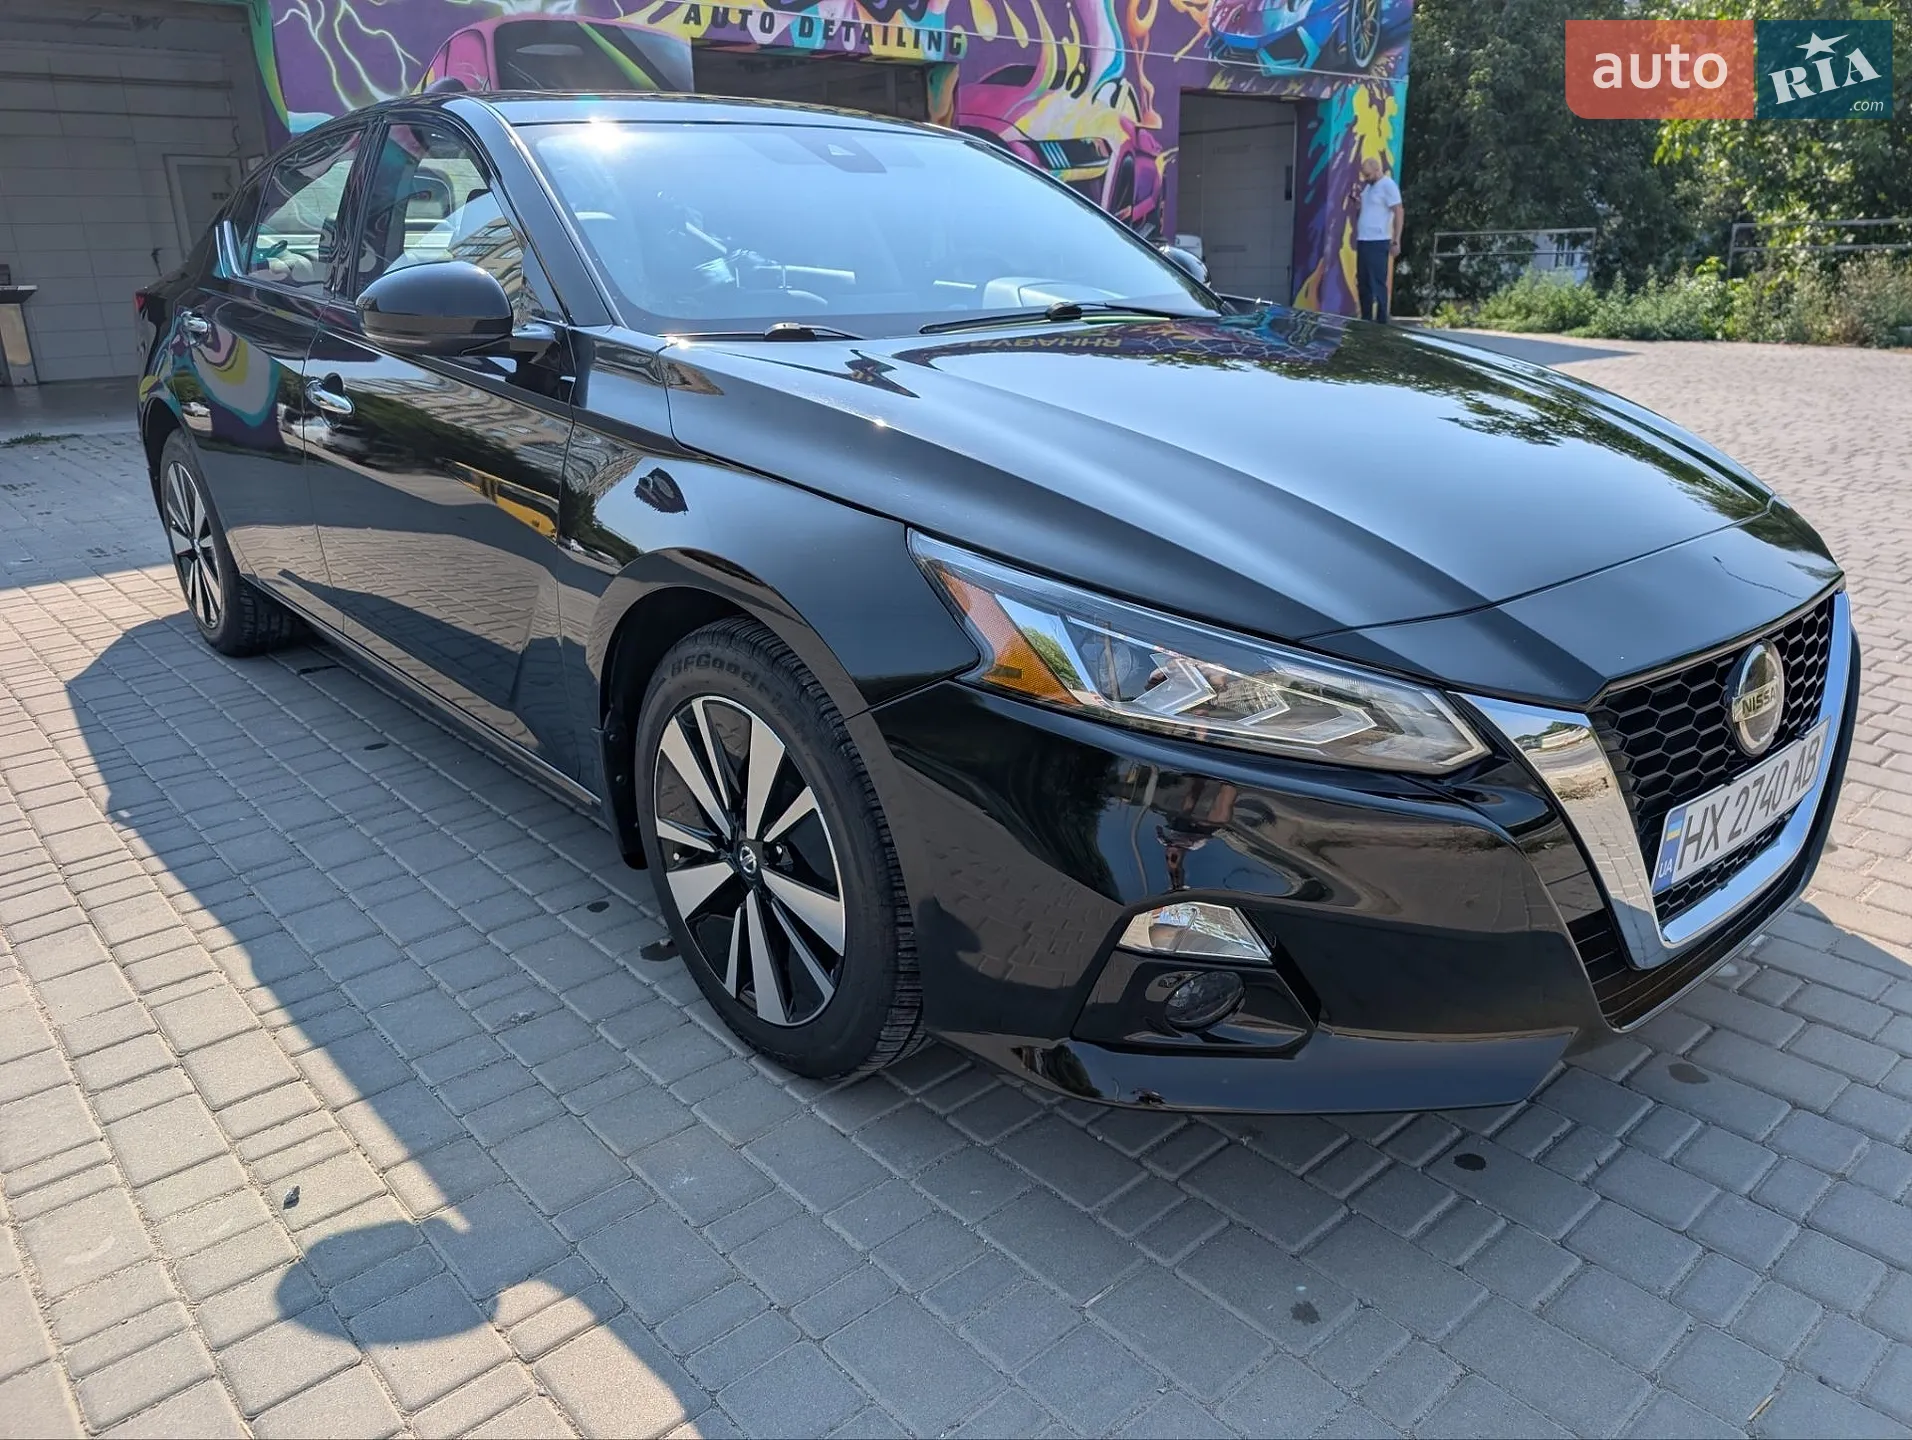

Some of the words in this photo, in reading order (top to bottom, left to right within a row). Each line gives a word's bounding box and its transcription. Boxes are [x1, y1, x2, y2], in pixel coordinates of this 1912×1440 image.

[683, 3, 775, 35] AUTO
[798, 16, 968, 56] DETAILING
[1678, 795, 1730, 871] HX
[1727, 759, 1789, 843] 2740
[1787, 735, 1821, 800] AB
[1658, 858, 1673, 878] UA
